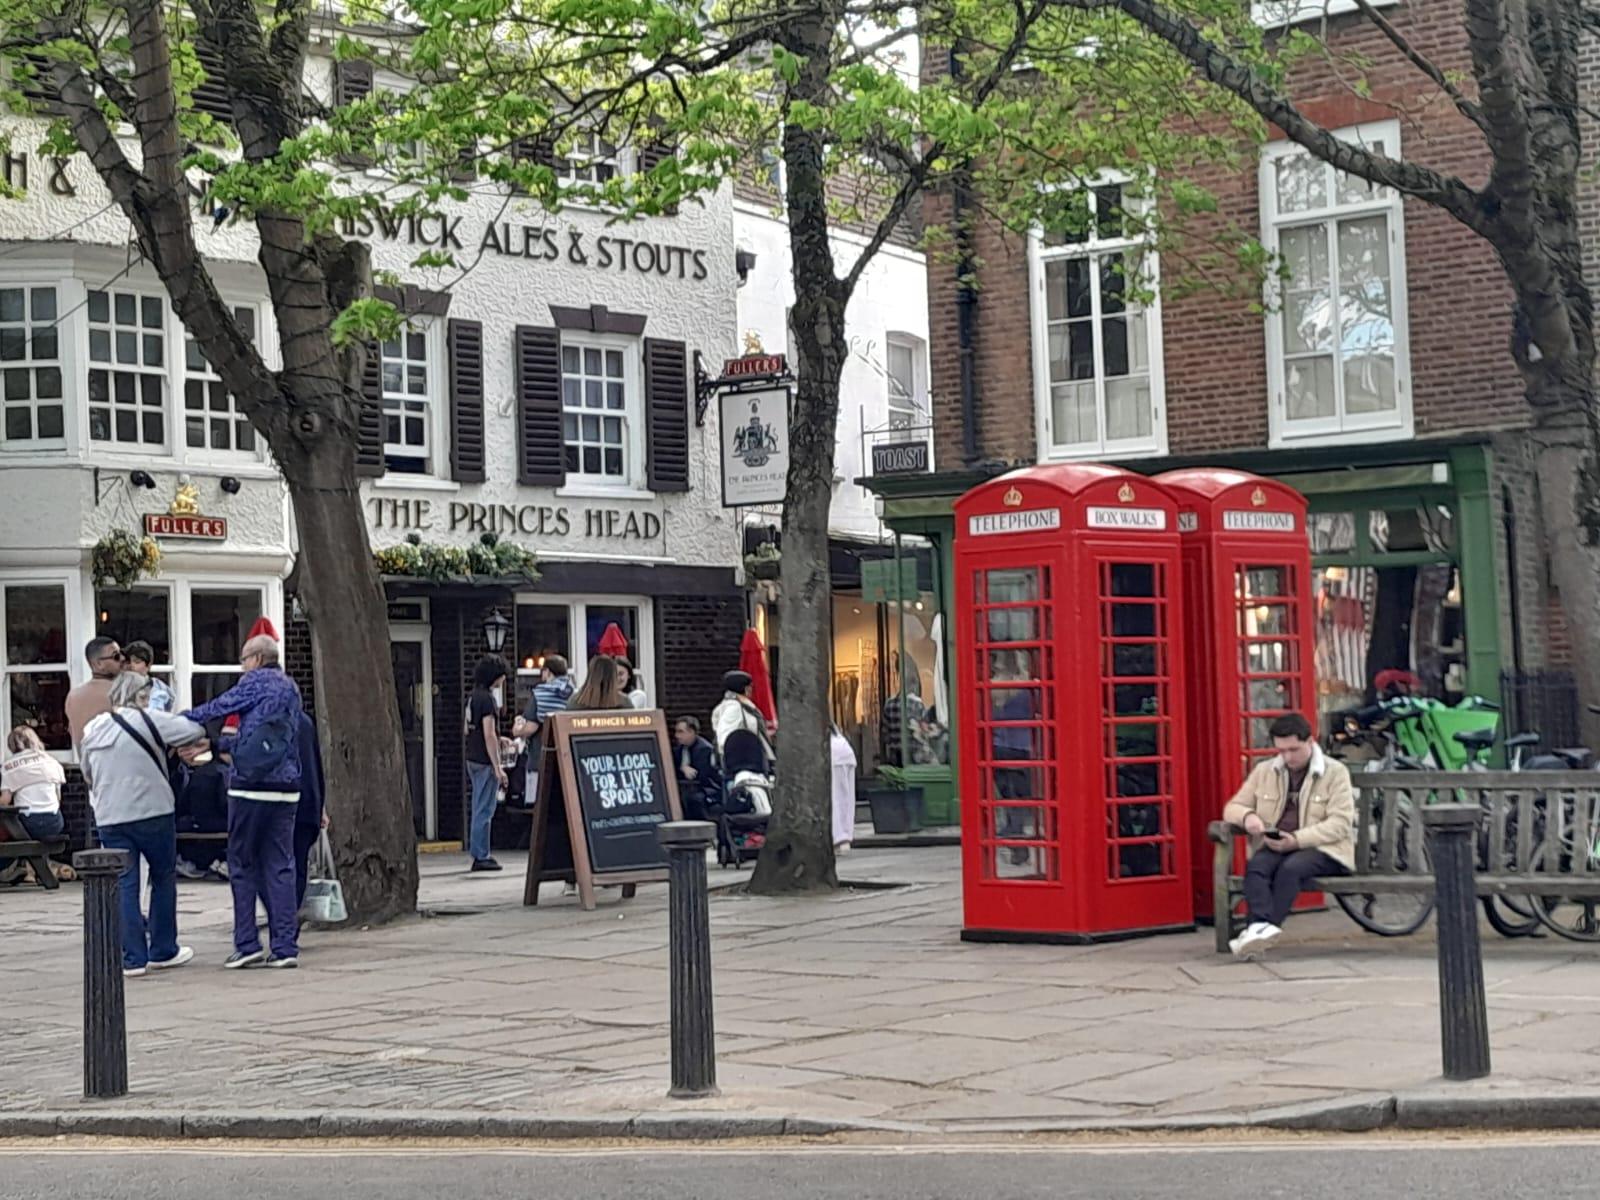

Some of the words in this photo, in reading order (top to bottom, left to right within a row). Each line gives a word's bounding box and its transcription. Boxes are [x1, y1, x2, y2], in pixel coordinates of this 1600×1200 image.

[49, 156, 78, 197] &
[479, 219, 560, 261] ALES
[567, 231, 588, 266] &
[597, 236, 708, 281] STOUTS
[874, 446, 926, 472] TOAST
[151, 516, 222, 537] FULLER'S
[367, 497, 433, 529] THE
[448, 501, 571, 536] PRINCES
[585, 509, 661, 540] HEAD
[973, 510, 1057, 532] TELEPHONE
[1095, 511, 1118, 524] BOX
[1120, 511, 1157, 526] WALKS
[1226, 511, 1291, 528] TELEPHONE
[581, 755, 617, 775] YOUR
[616, 752, 655, 771] LOCAL
[592, 773, 618, 792] FOR
[621, 769, 653, 790] LIVE
[600, 786, 654, 808] SPORTS
